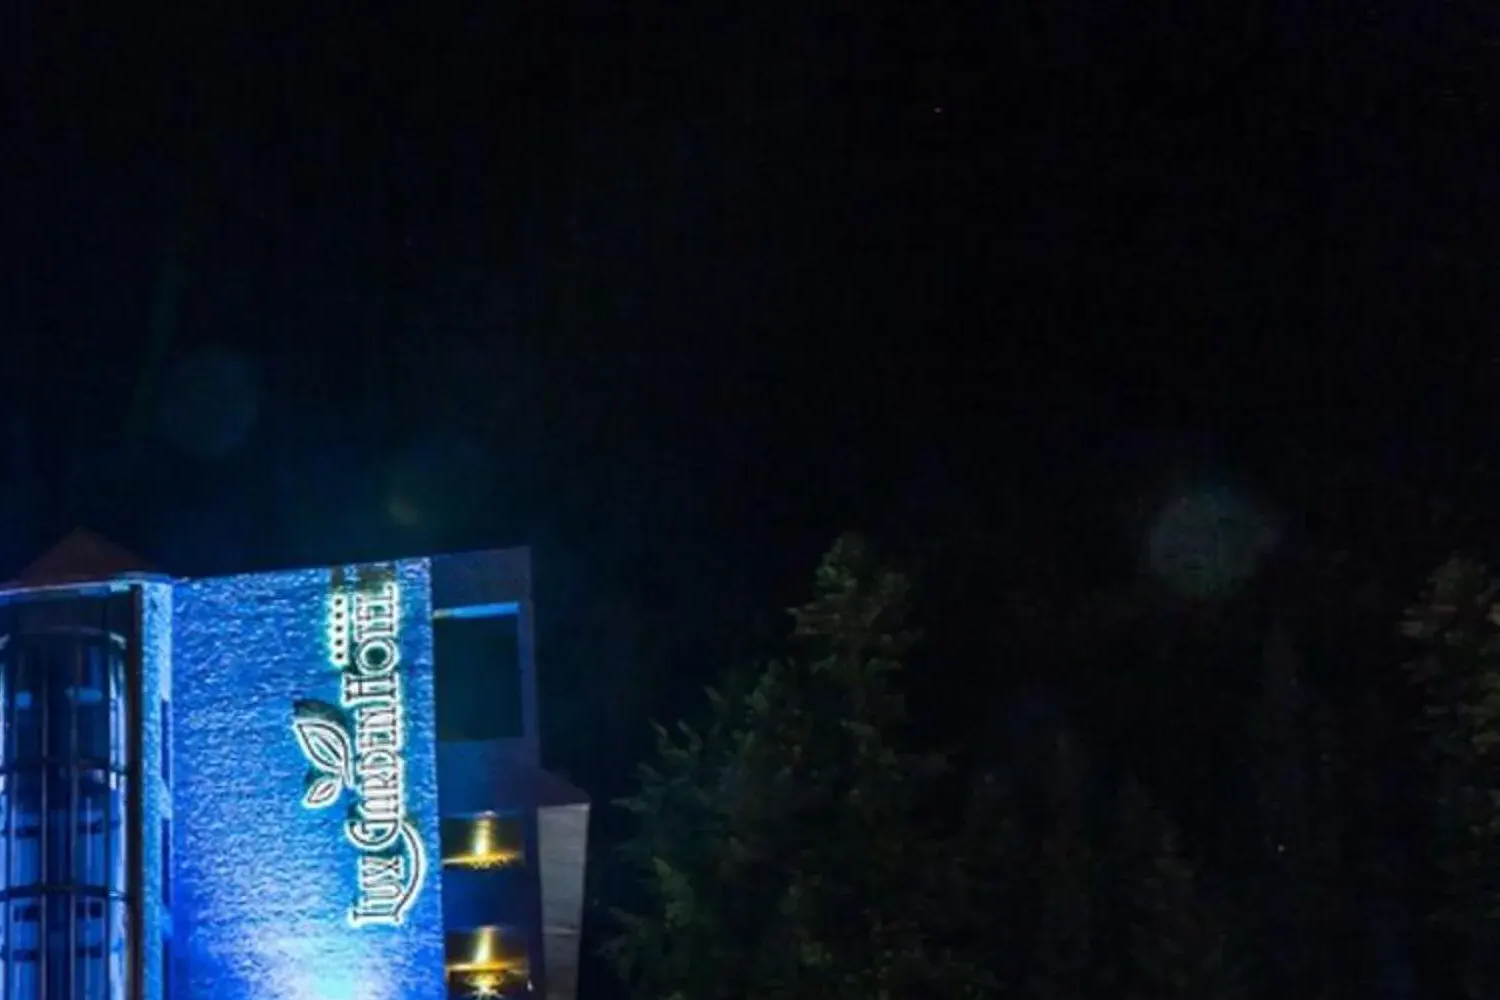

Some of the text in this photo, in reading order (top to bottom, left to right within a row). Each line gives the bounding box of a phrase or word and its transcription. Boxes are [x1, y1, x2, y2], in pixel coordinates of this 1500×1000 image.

[343, 583, 419, 925] LUX GARDEN HOTEL
